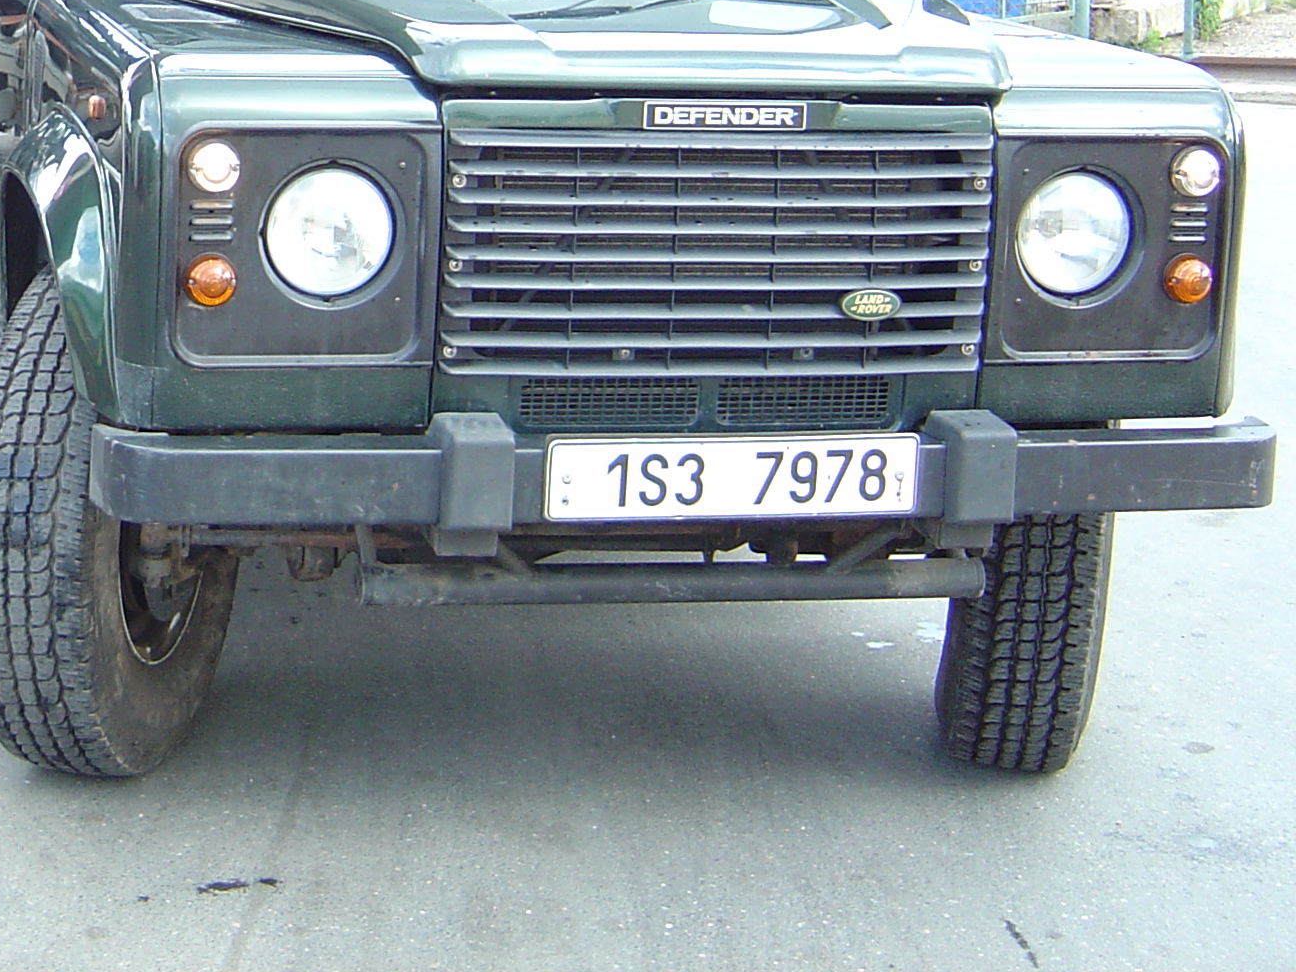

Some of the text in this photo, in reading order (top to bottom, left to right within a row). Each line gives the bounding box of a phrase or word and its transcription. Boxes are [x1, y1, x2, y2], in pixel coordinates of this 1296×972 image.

[654, 107, 794, 125] DEFENDER
[854, 294, 884, 305] LAND
[856, 304, 892, 314] ROVER
[607, 448, 888, 508] 1S3 7978
